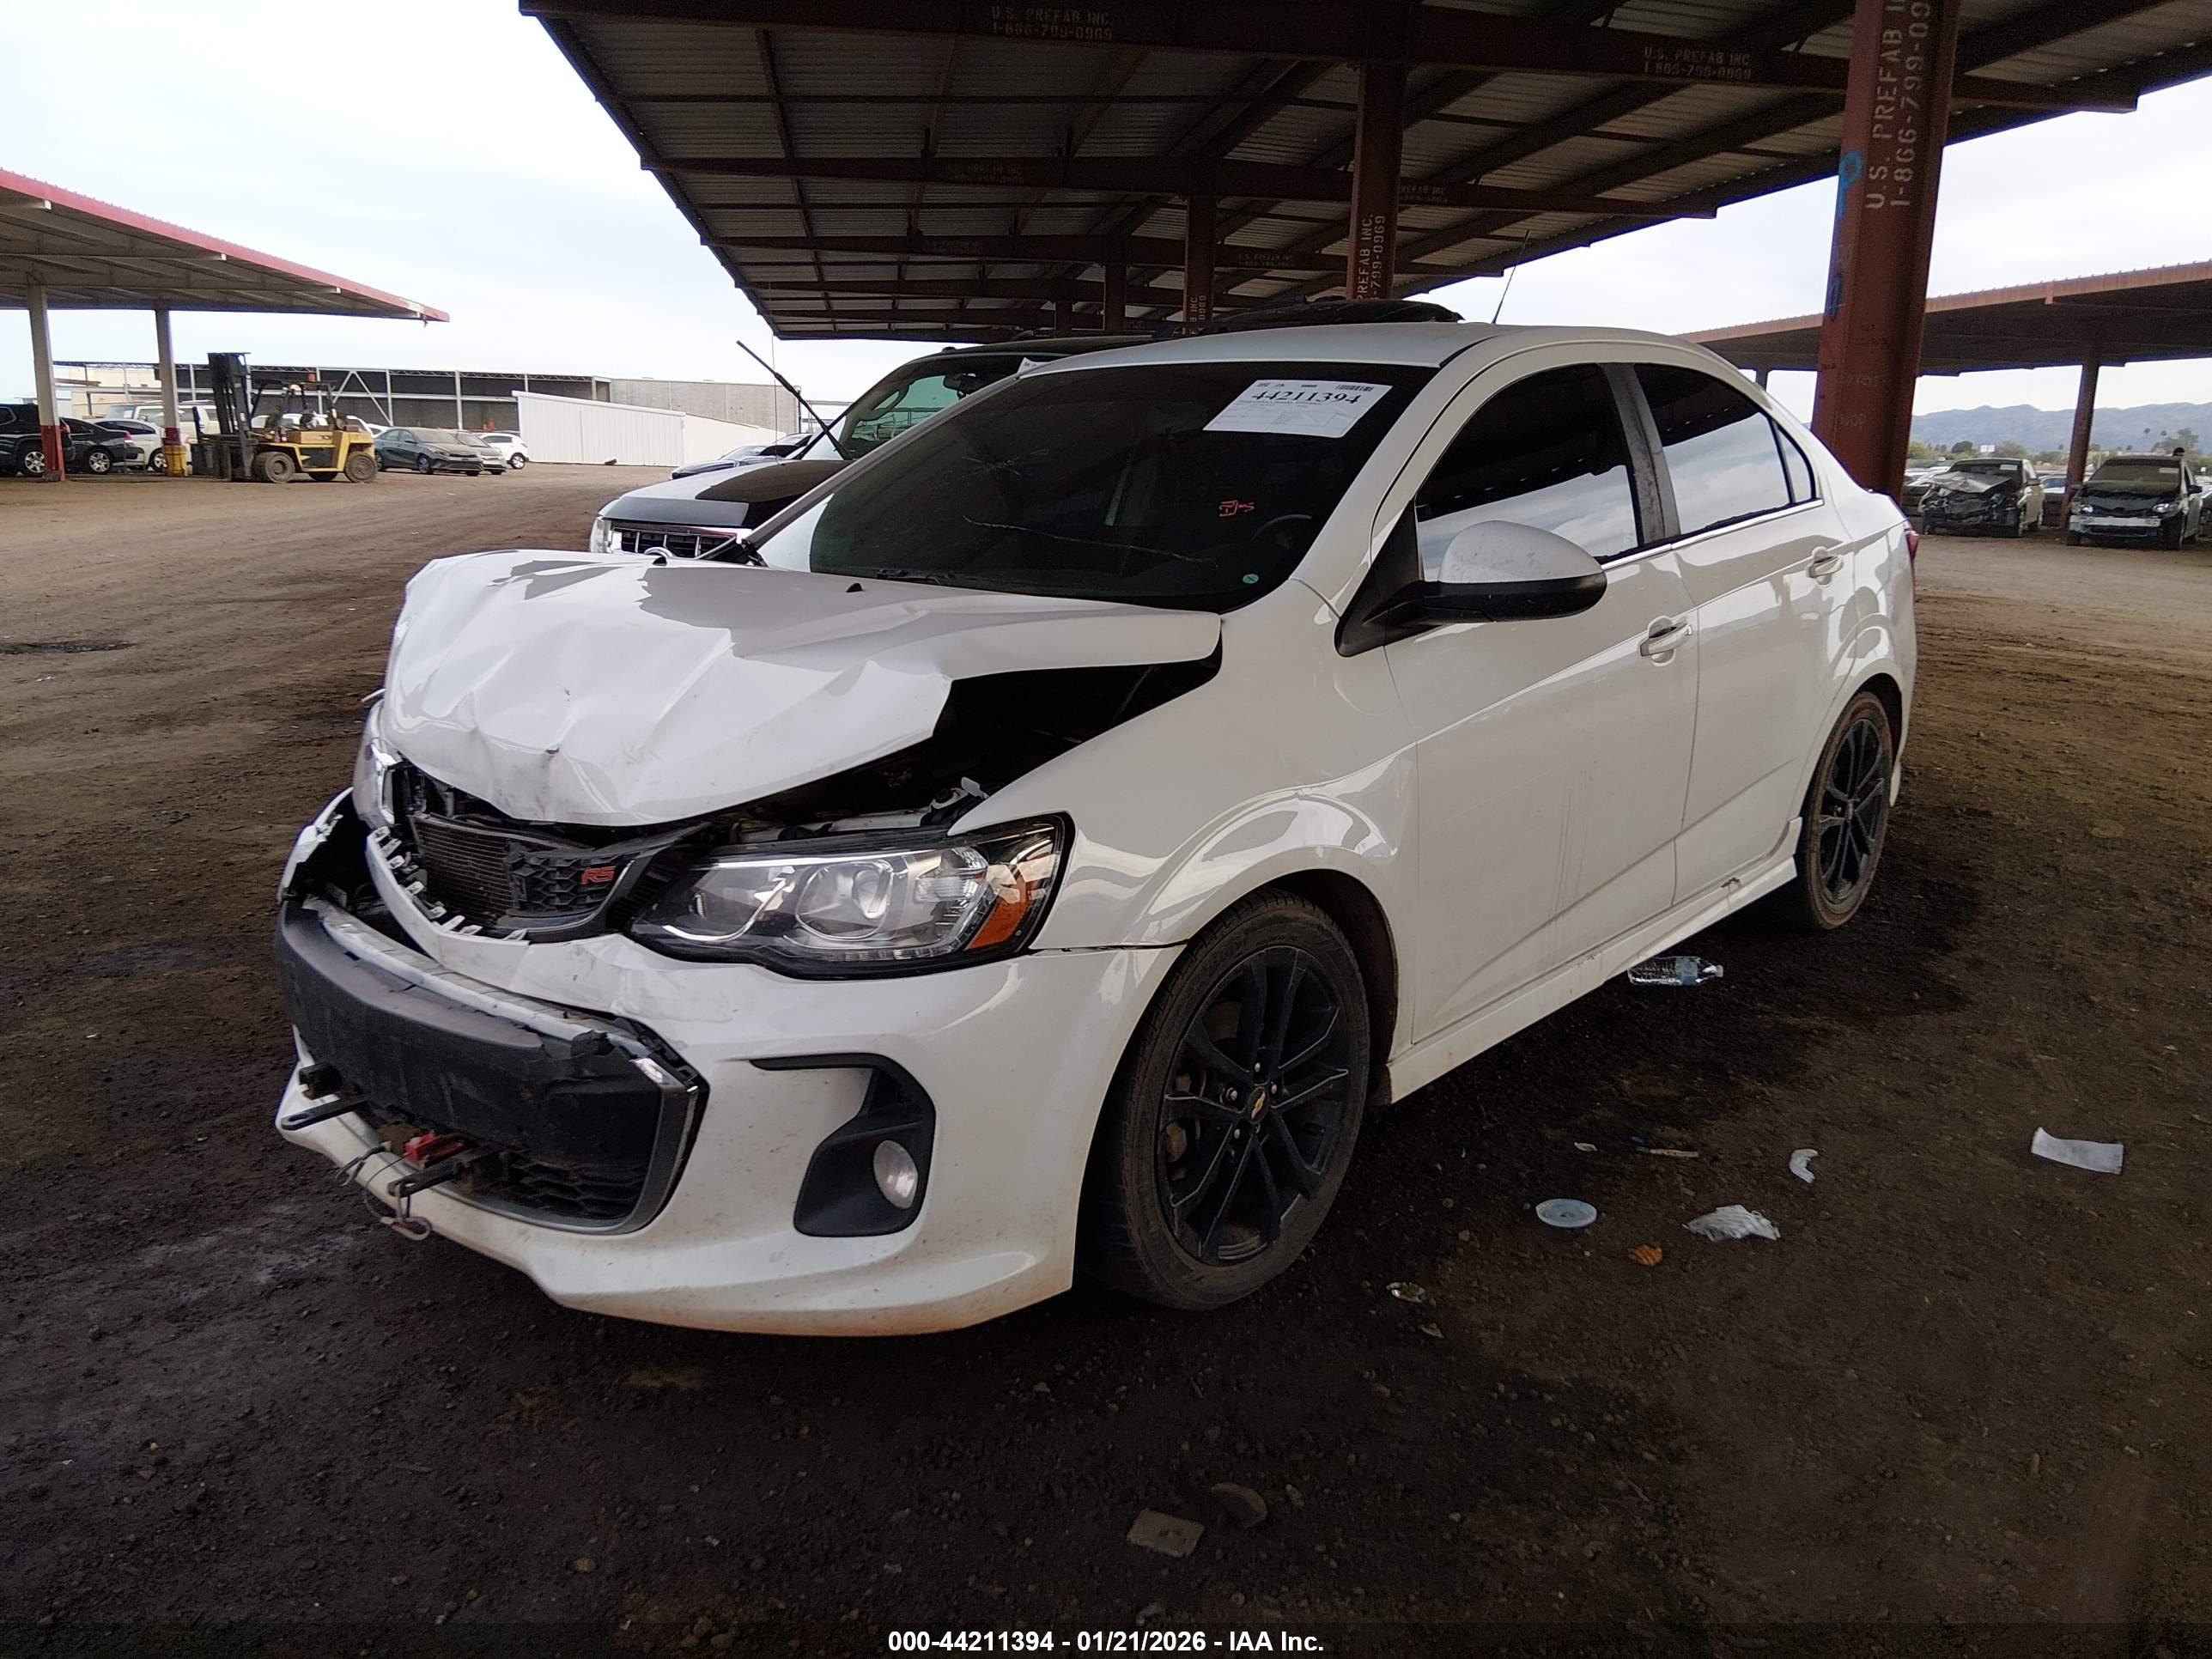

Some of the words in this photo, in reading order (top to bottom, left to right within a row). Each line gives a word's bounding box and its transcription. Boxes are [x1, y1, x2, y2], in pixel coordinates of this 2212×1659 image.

[1872, 28, 1904, 138] PREFAB
[1866, 158, 1891, 209] U.S.
[1252, 391, 1362, 404] 44211394
[580, 866, 616, 884] RS
